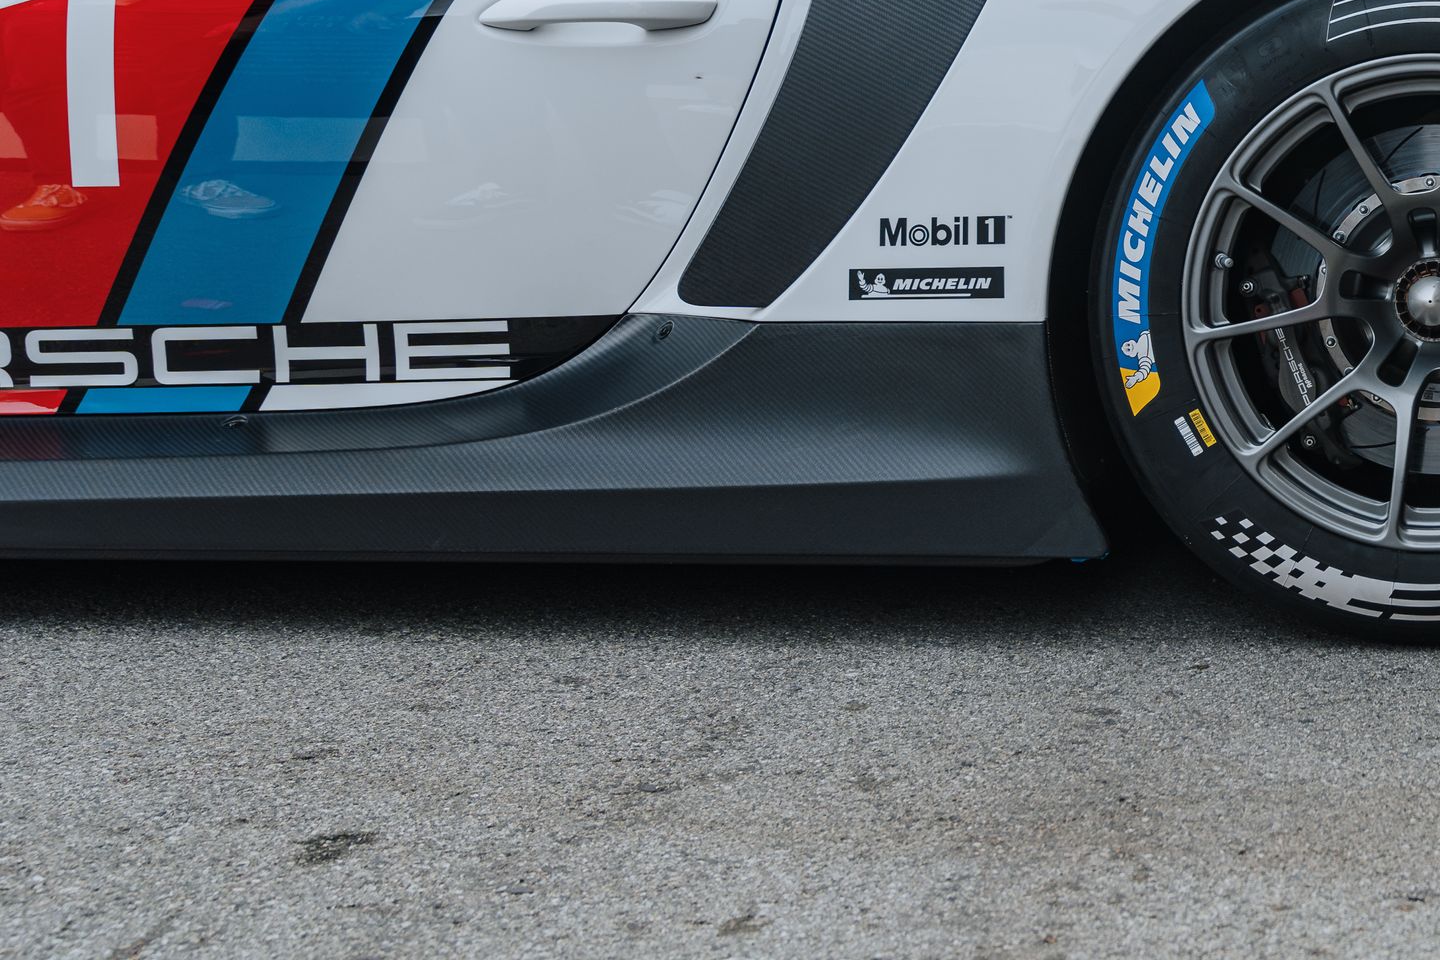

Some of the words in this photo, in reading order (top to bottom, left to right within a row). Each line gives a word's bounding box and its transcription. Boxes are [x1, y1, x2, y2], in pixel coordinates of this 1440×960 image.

[879, 216, 969, 247] Mobil
[1117, 101, 1202, 325] MICHELIN
[892, 277, 992, 291] MICHELIN
[0, 320, 511, 388] SCHE
[1274, 327, 1311, 406] PORSCHE
